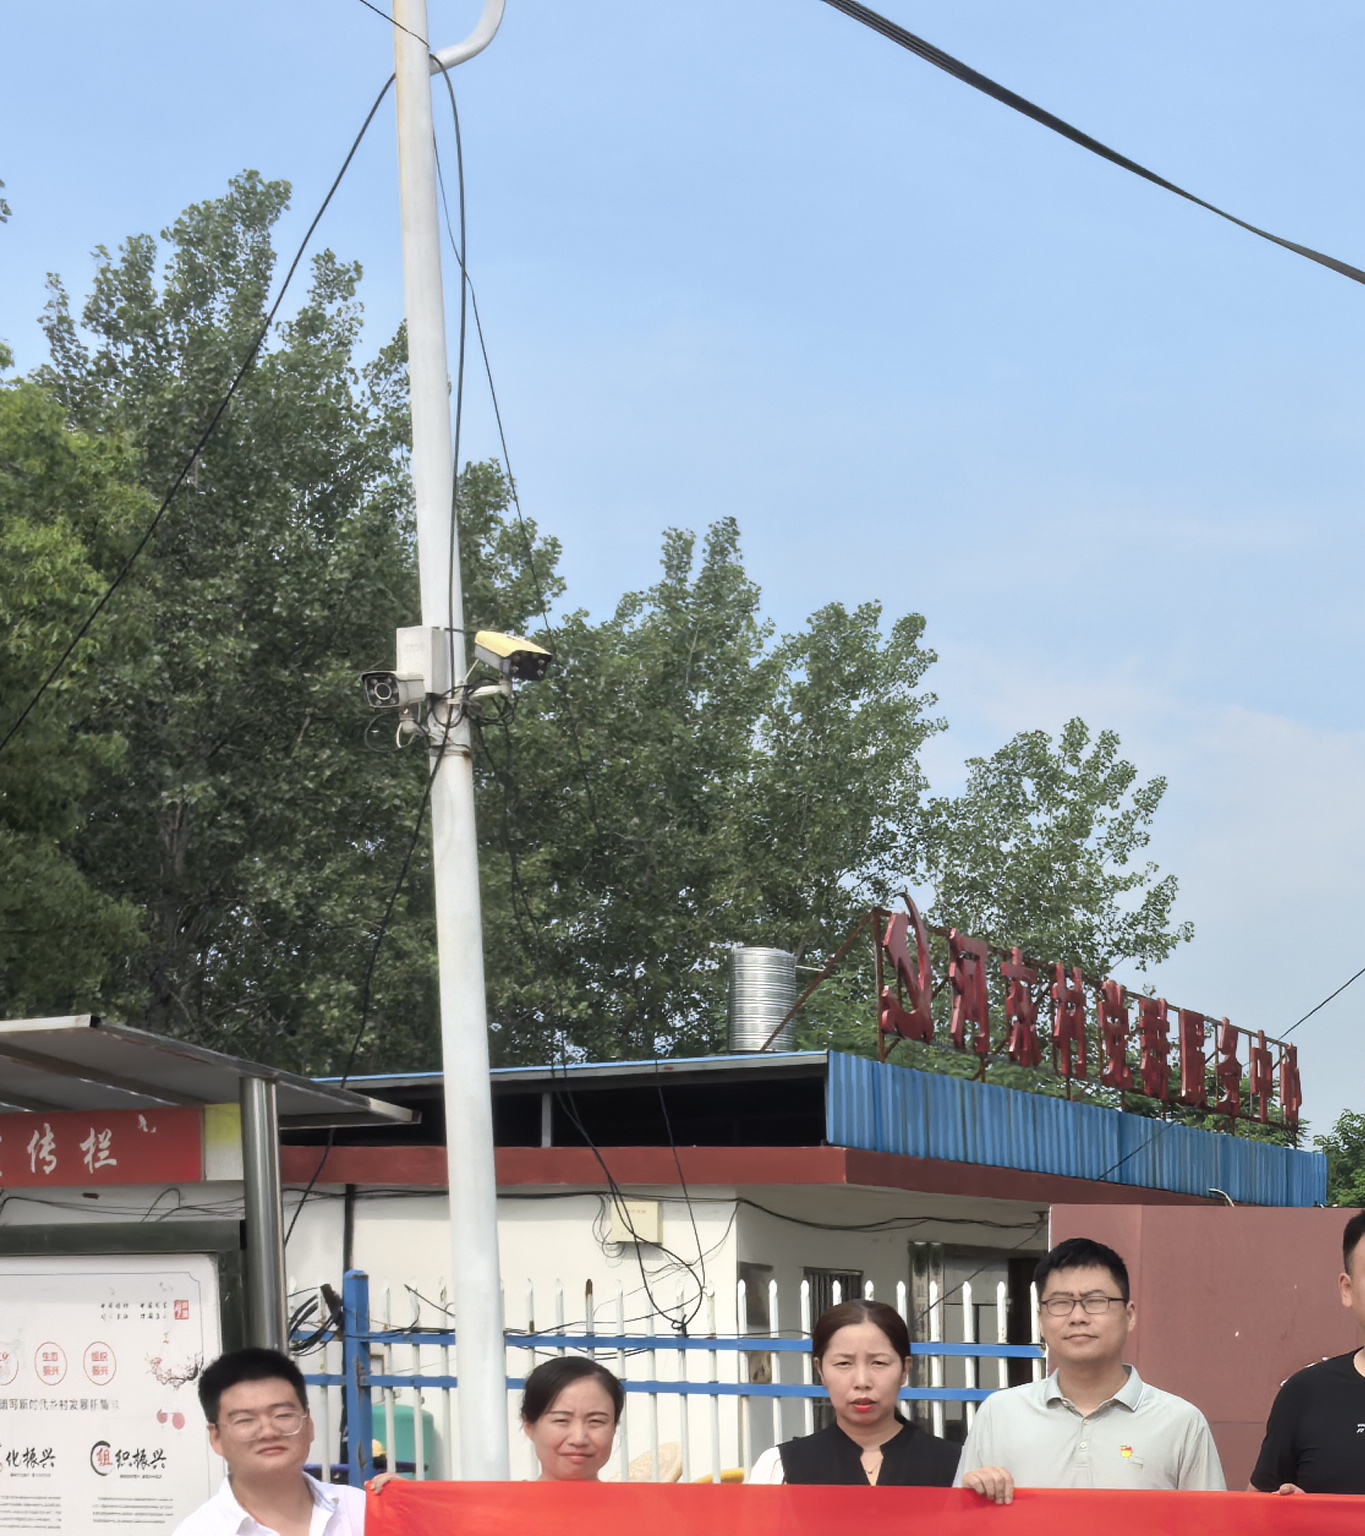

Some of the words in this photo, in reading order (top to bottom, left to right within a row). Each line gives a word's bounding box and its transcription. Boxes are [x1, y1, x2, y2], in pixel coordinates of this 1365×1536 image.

[0, 1121, 118, 1176] 传栏
[0, 1446, 56, 1470] 化振兴
